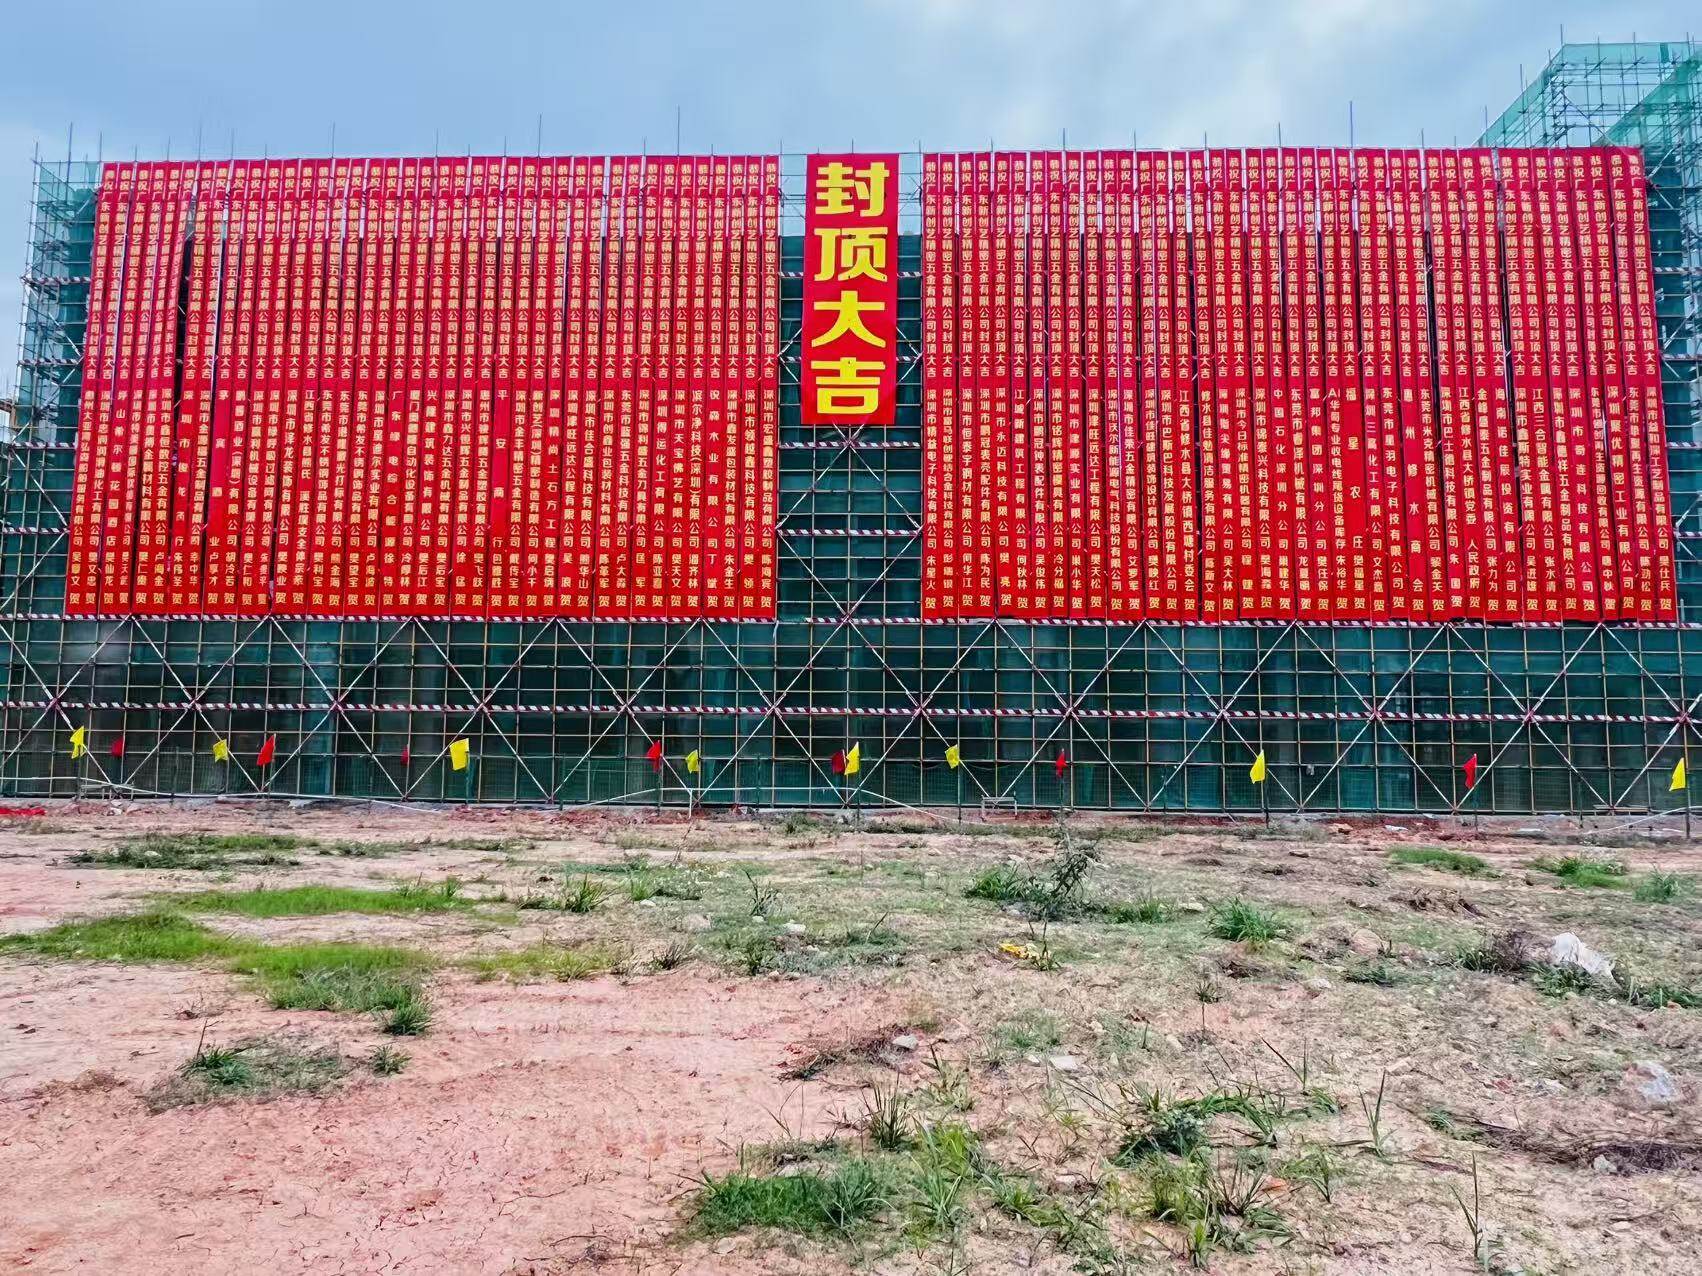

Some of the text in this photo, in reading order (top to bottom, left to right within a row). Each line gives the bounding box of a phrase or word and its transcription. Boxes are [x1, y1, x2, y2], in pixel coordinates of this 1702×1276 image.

[811, 161, 890, 414] 封顶大吉
[492, 389, 508, 545] 平安商行
[1273, 390, 1288, 549] 中国石化深圳分公司
[1309, 388, 1327, 548] 富邦集团深圳分公司
[1345, 387, 1363, 548] 福星农庄
[1402, 389, 1423, 590] 惠州修水商会
[1467, 540, 1479, 588] 人民政府
